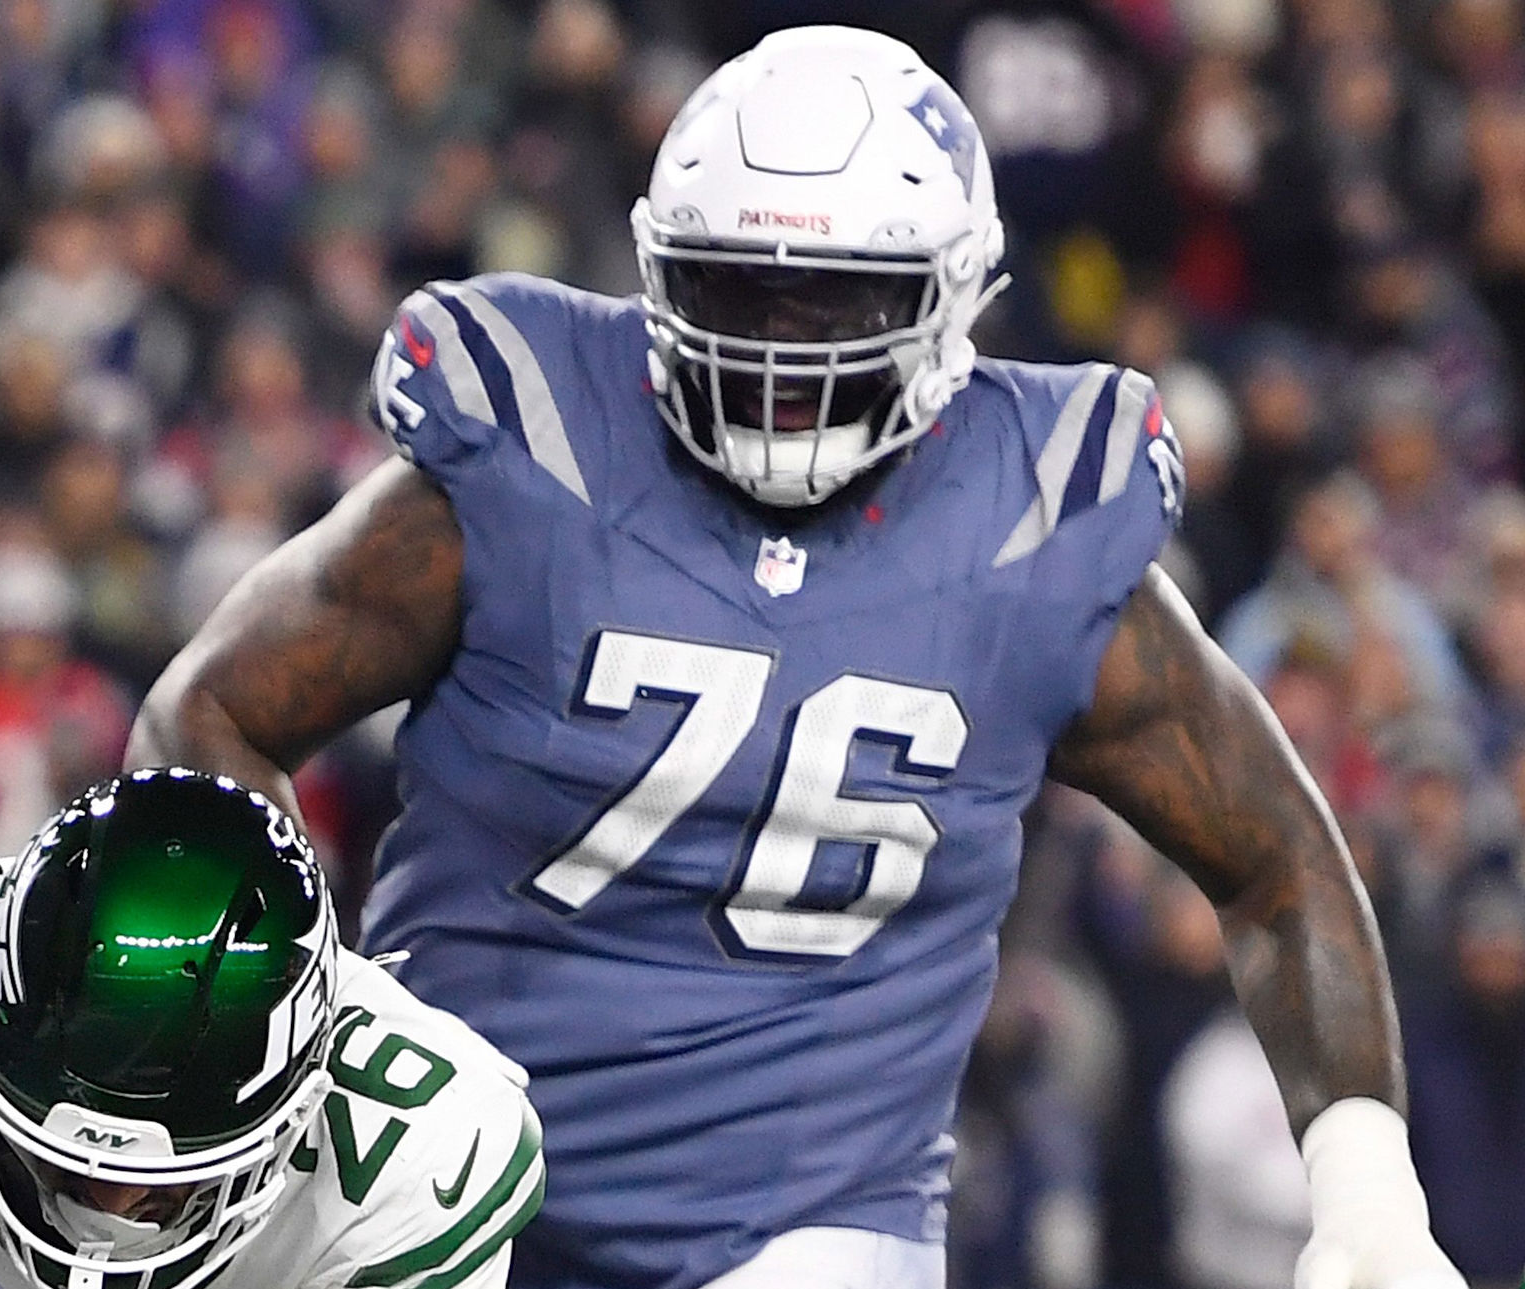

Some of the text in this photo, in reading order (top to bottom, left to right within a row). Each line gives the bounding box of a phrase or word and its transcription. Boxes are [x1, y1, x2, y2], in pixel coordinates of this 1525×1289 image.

[737, 209, 831, 236] PATRIOTS
[515, 624, 971, 965] 76
[73, 1126, 140, 1149] NY
[325, 1005, 457, 1207] 26
